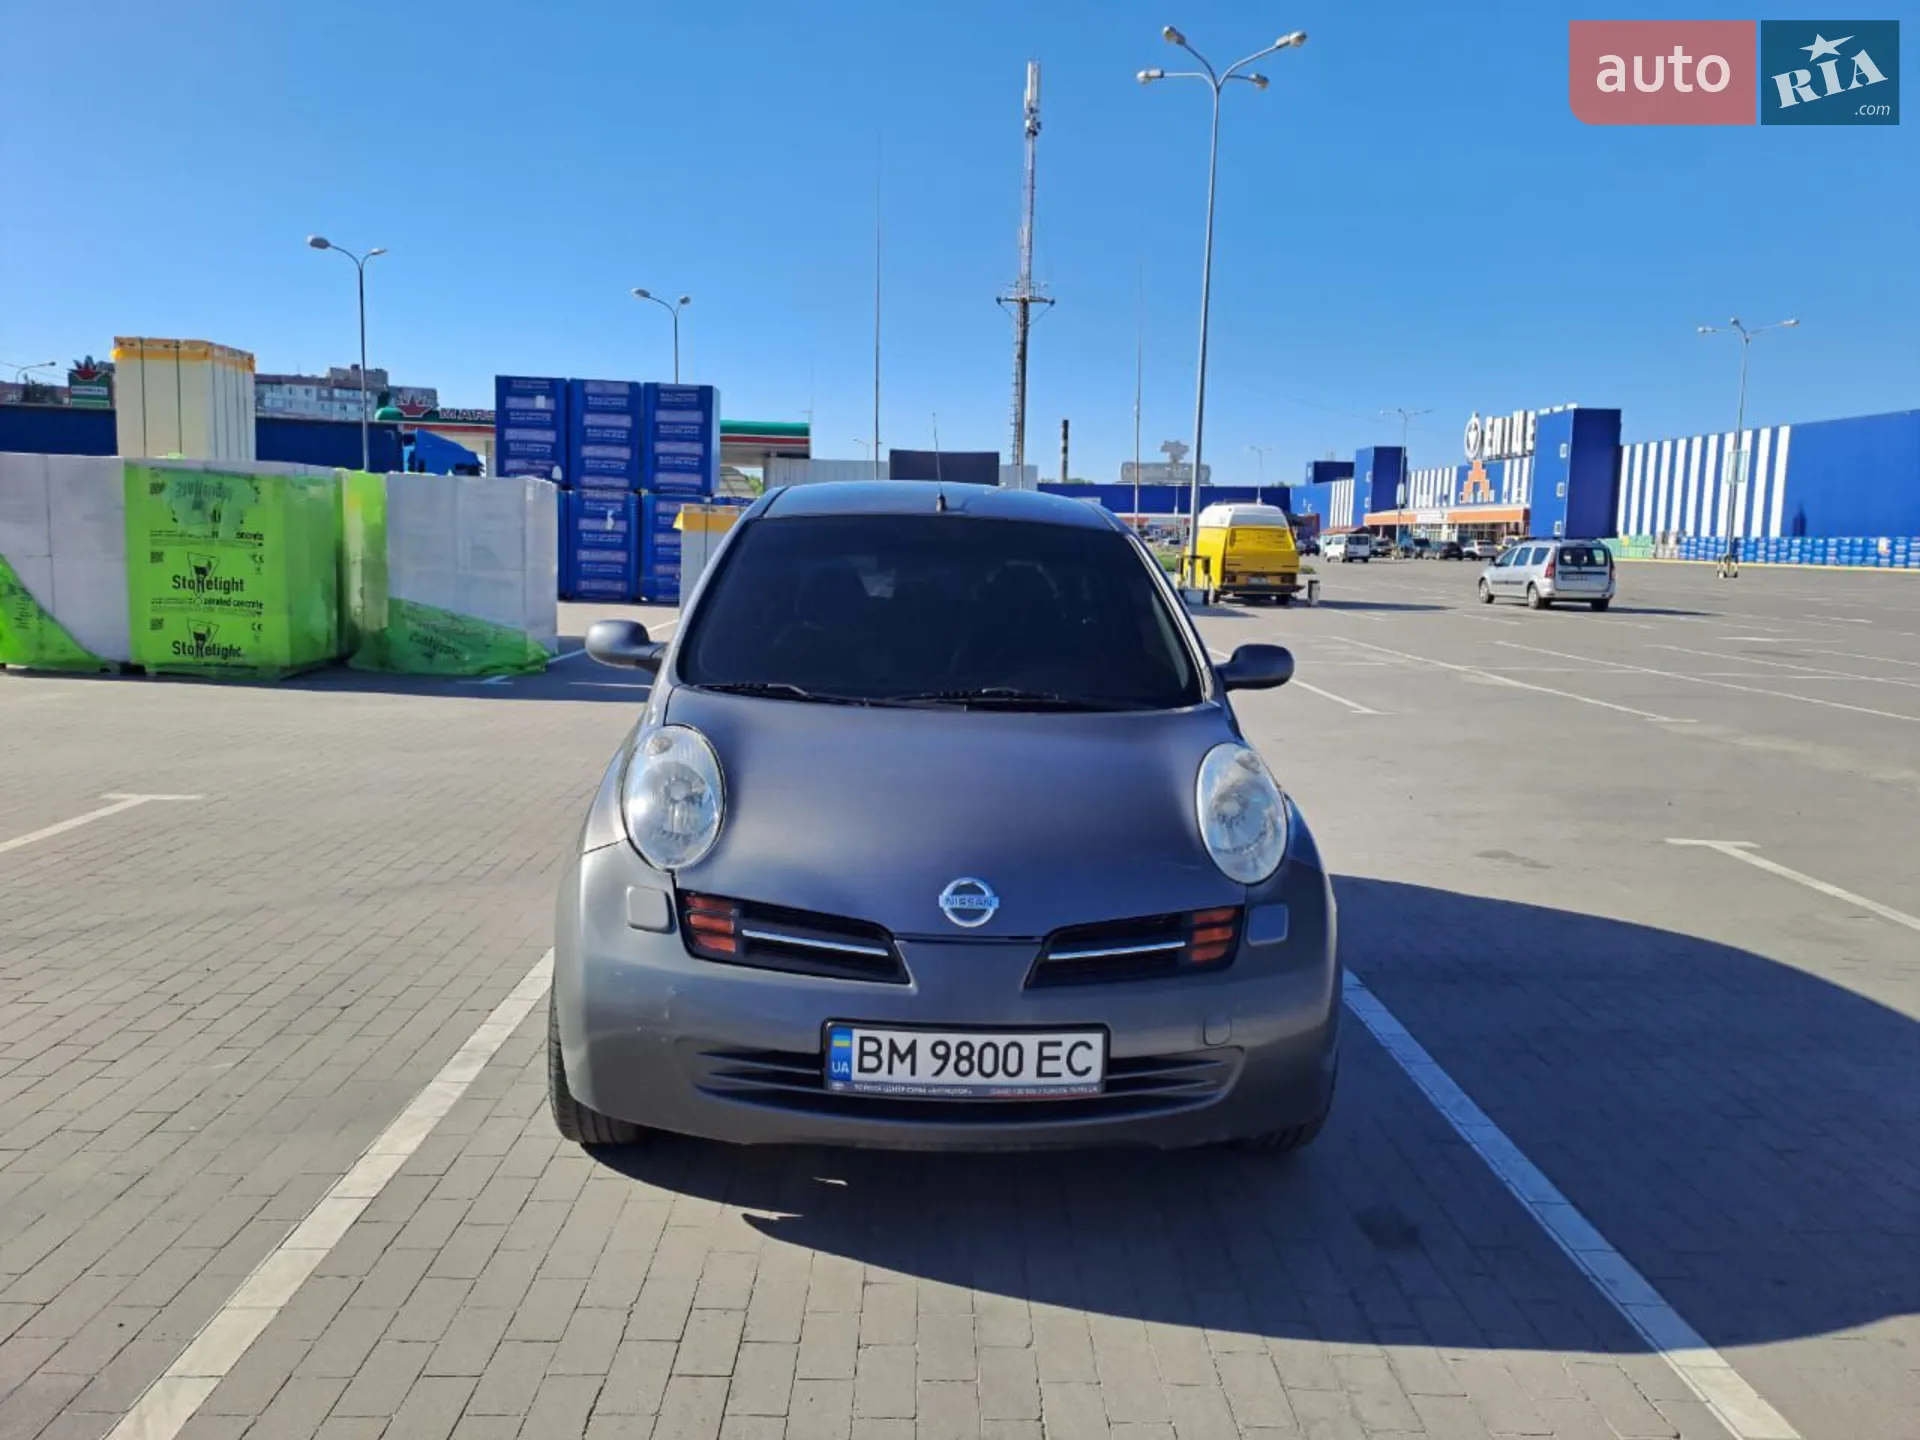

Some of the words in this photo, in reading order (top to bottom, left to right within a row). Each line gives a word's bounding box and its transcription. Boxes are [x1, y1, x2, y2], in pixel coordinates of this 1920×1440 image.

[171, 574, 245, 595] Stonelight
[171, 640, 244, 661] Stonelight
[945, 896, 993, 907] NISSAN
[831, 1061, 850, 1075] UA
[857, 1036, 918, 1077] BM
[929, 1040, 1024, 1079] 9800
[1036, 1040, 1094, 1078] EC
